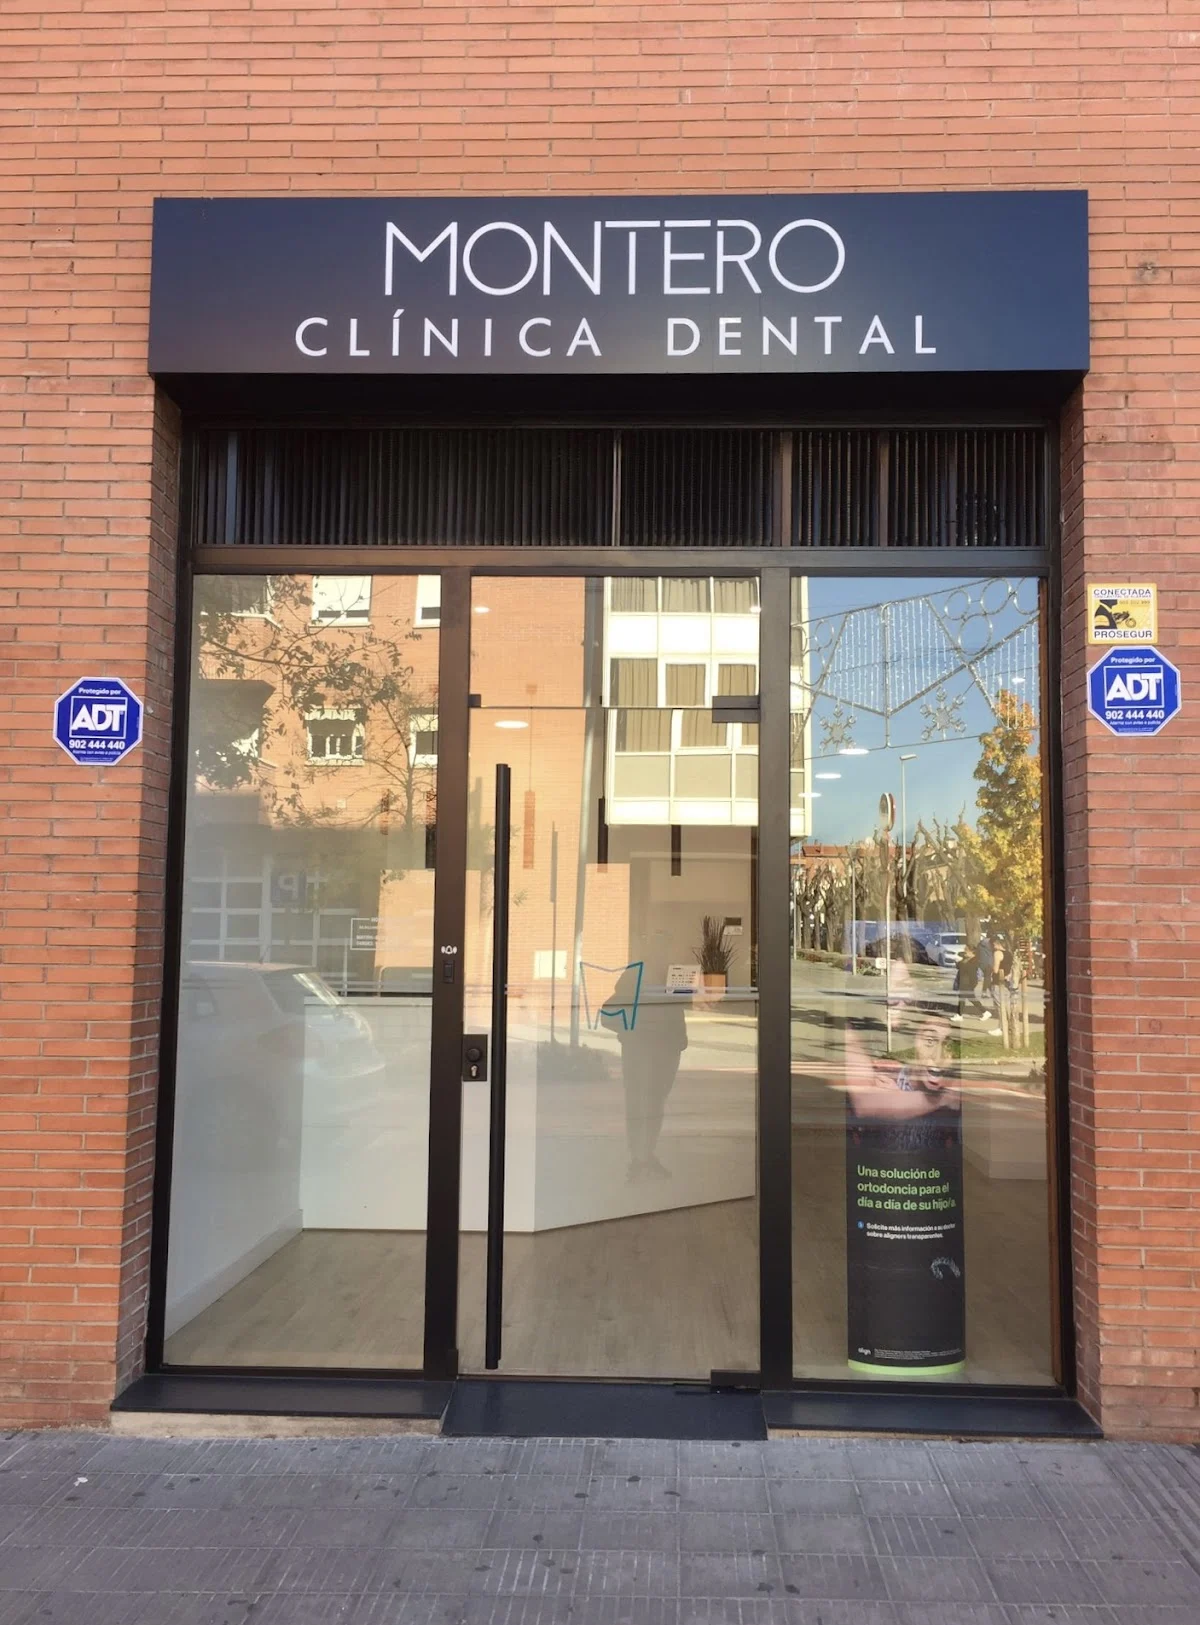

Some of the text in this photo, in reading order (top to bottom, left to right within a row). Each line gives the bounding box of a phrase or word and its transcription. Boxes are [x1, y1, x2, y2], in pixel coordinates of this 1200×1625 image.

[385, 219, 845, 295] MONTERO
[296, 309, 936, 356] CLÍNICA DENTAL
[1093, 588, 1151, 596] CONECTADA
[1094, 630, 1153, 639] PROSEGUR
[1110, 656, 1156, 664] Protegido por
[78, 687, 110, 696] Protegido
[1106, 672, 1162, 701] ADT
[71, 703, 126, 732] ADT
[1105, 710, 1165, 720] 902 444 440
[69, 739, 125, 750] 902 444 440
[857, 1164, 941, 1180] Una solución de
[857, 1182, 950, 1197] ortodoncia para el
[875, 1201, 882, 1209] a
[902, 1200, 918, 1211] de
[919, 1201, 931, 1211] su
